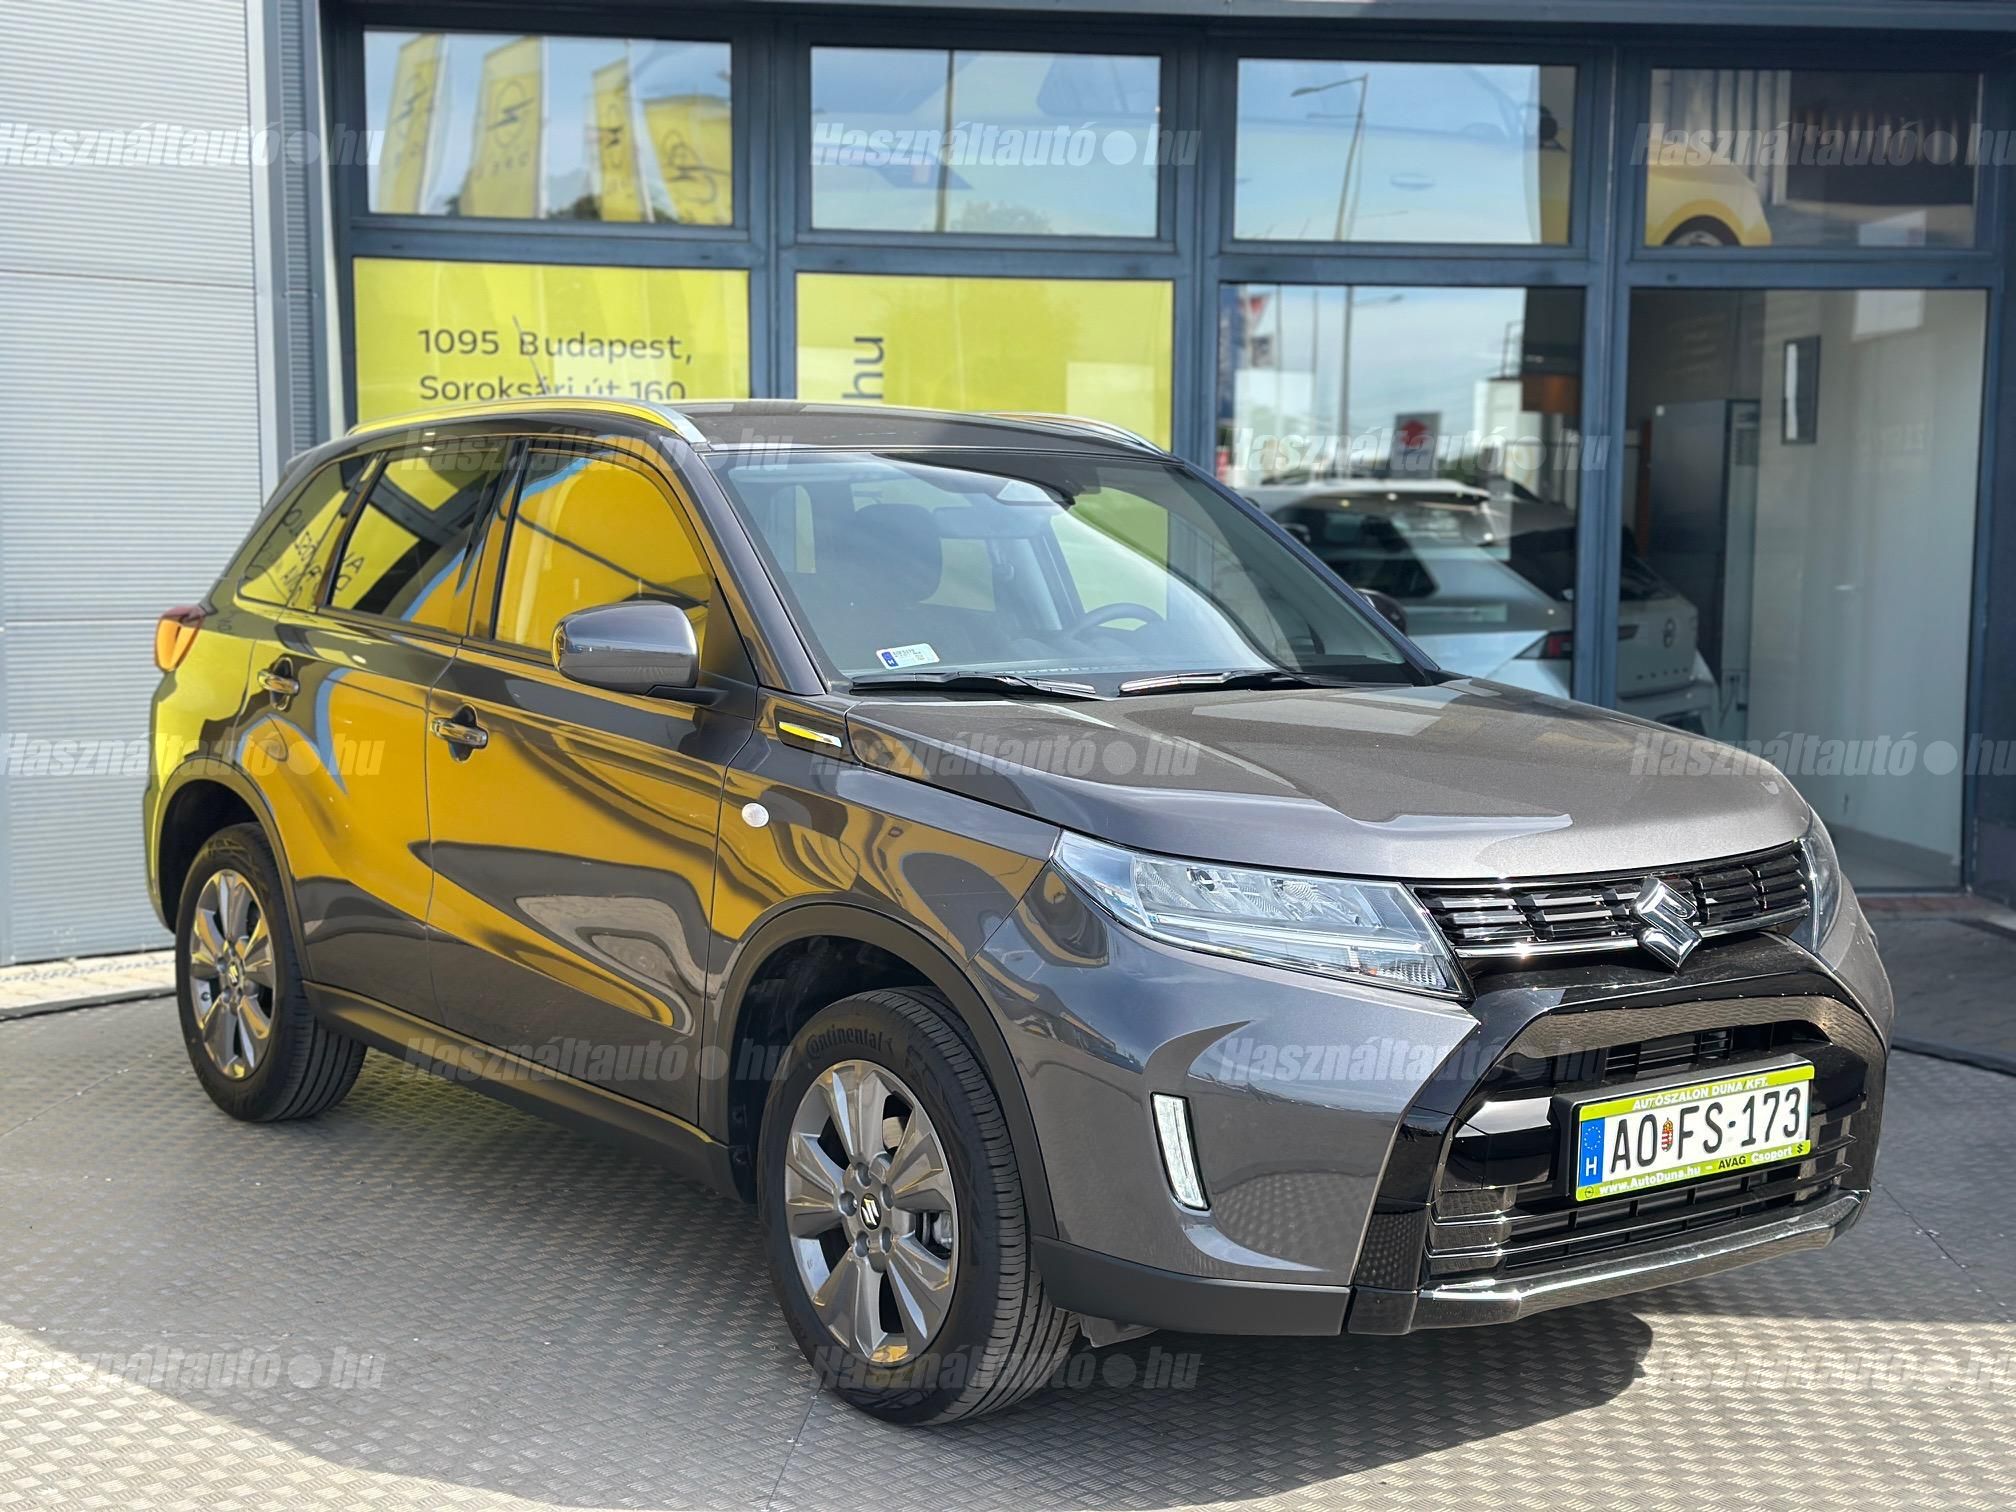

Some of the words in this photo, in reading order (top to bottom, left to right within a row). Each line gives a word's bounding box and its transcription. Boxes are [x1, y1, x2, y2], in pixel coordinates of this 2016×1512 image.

[418, 329, 499, 354] 1095
[518, 331, 692, 364] Budapest,
[806, 1024, 883, 1058] Continental
[1712, 1081, 1743, 1096] DUNA
[1585, 1156, 1598, 1177] H
[1599, 1165, 1701, 1195] www.AutoDuna.hu
[1717, 1155, 1747, 1170] AVAG
[1751, 1146, 1793, 1164] Csoport
